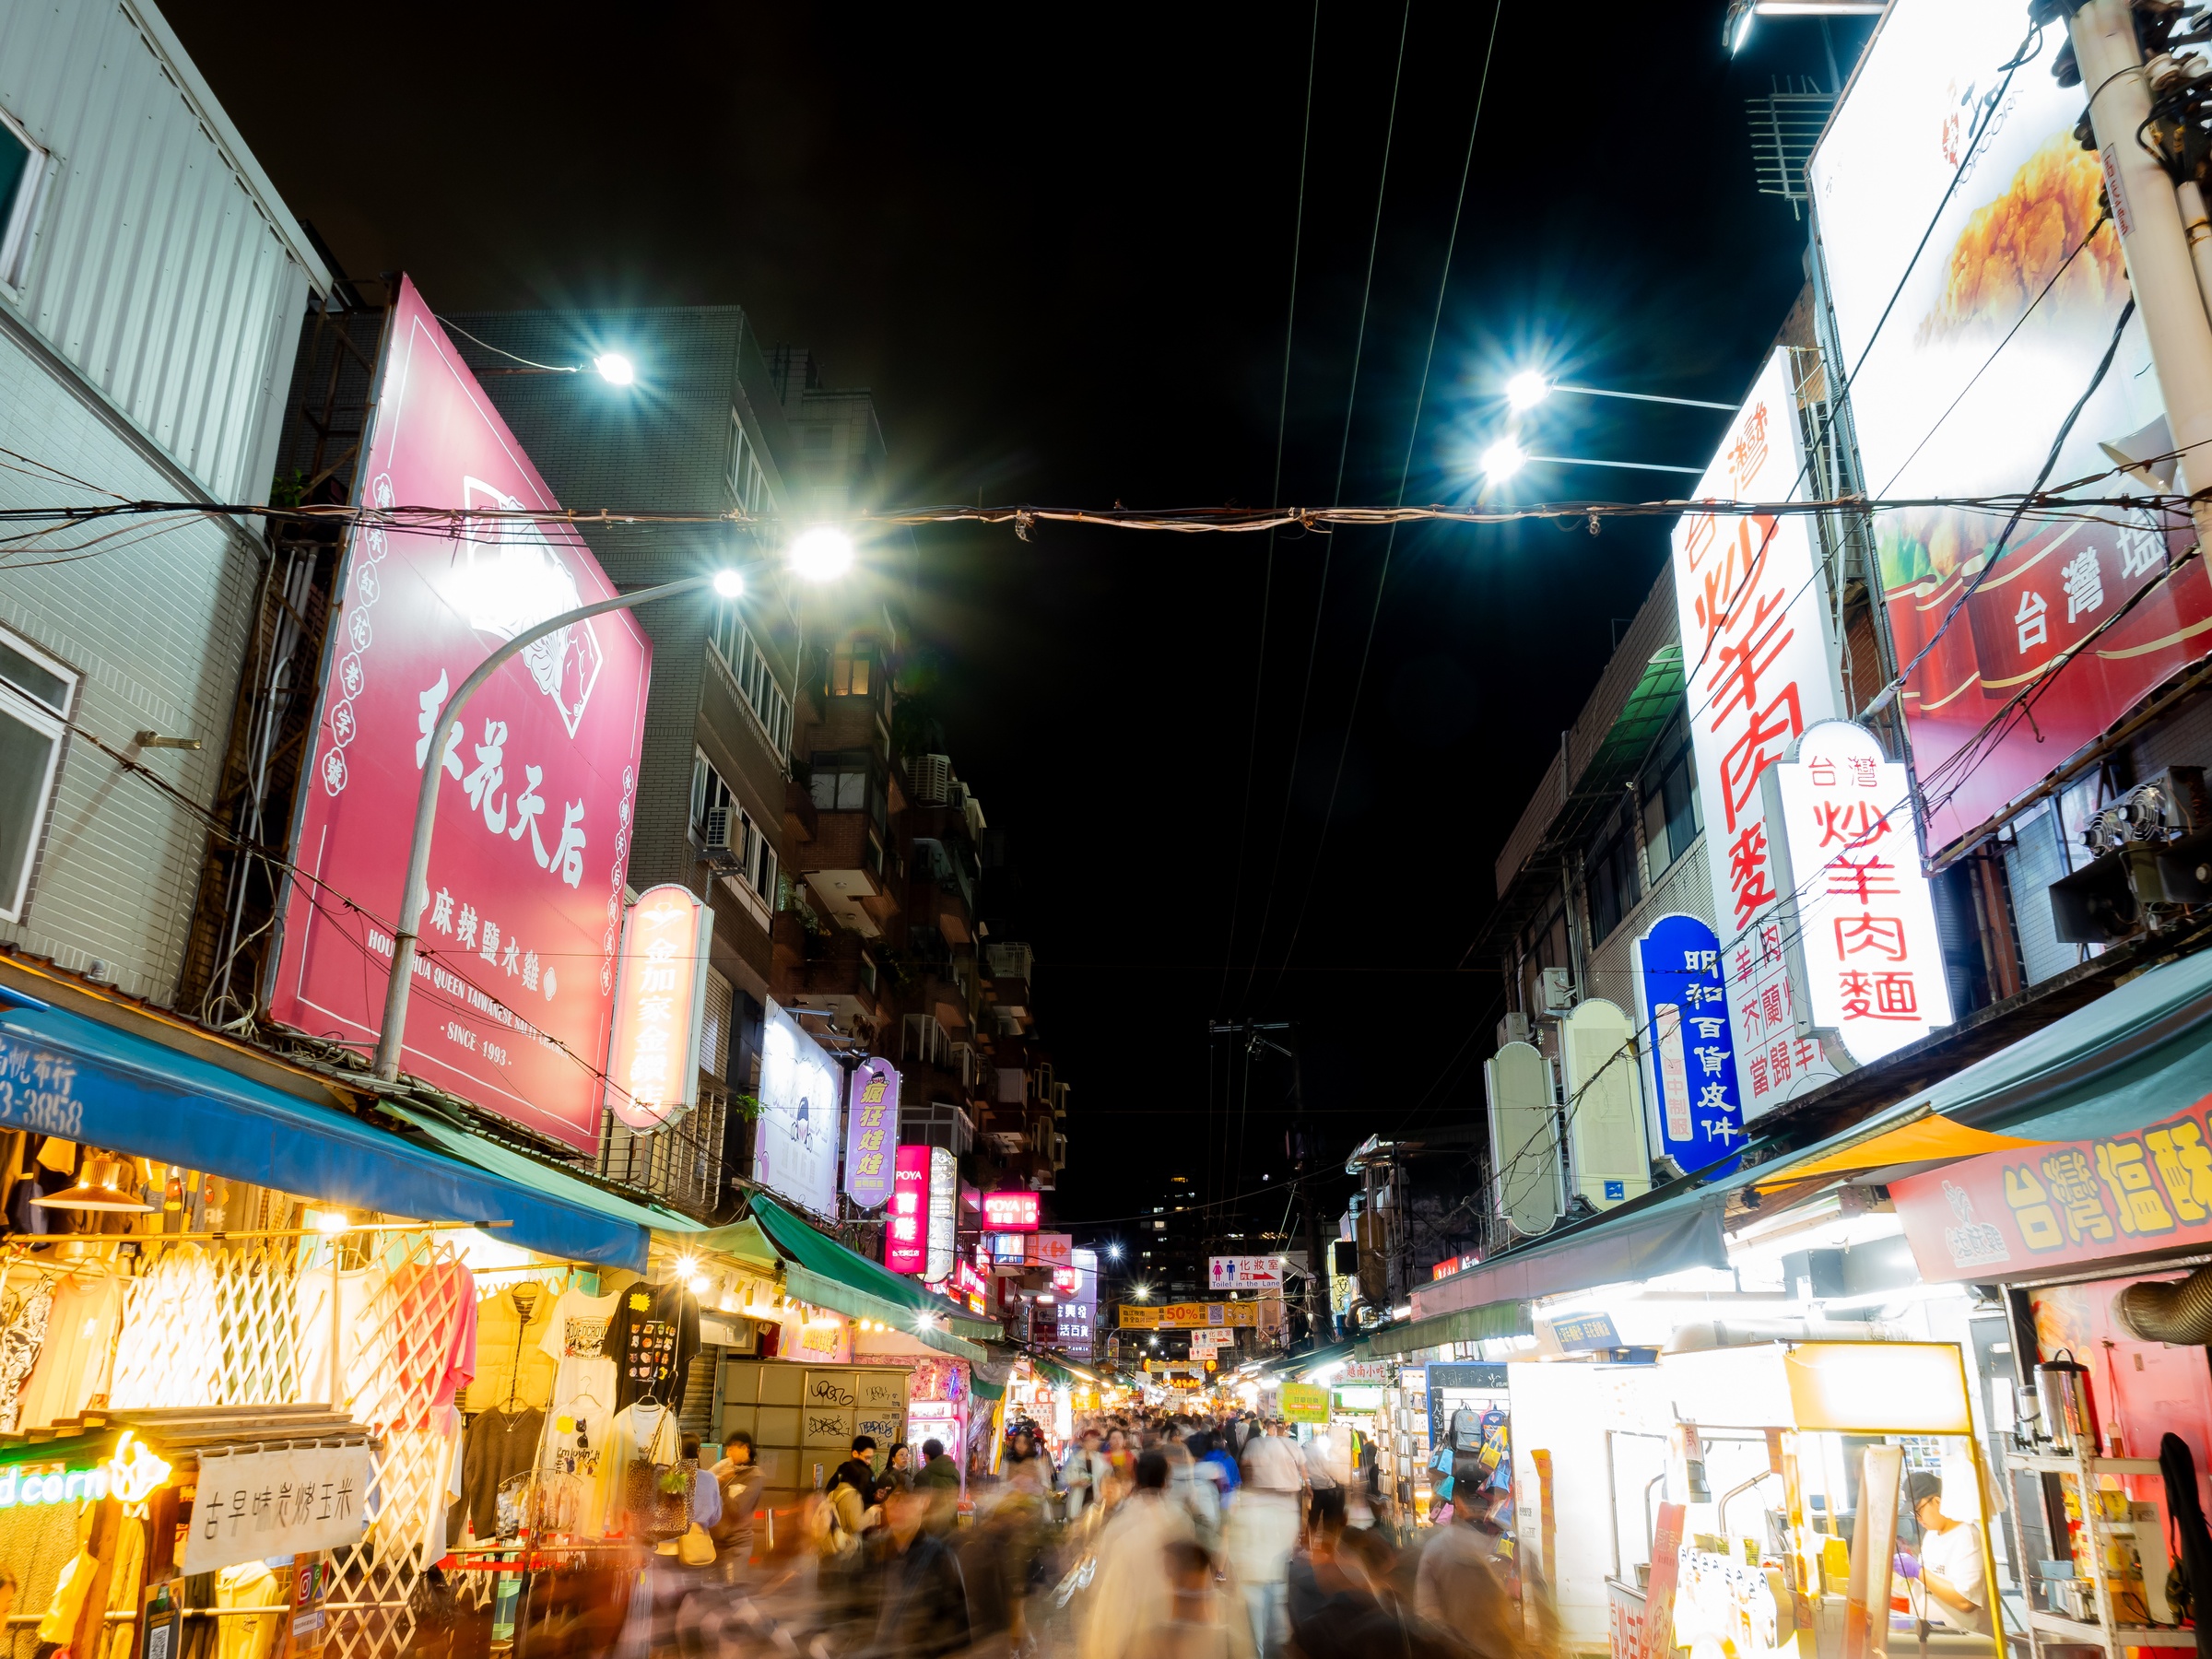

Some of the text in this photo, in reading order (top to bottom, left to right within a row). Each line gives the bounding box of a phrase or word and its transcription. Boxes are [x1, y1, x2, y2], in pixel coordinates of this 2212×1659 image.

[1808, 756, 1877, 787] 台灣
[434, 967, 465, 1002] QUEEN
[447, 1021, 506, 1066] SINCE 1993
[1684, 950, 1739, 1147] 明和百貨皮件
[856, 1083, 888, 1176] 瘋狂娃娃
[896, 1171, 922, 1180] POYA
[985, 1199, 1037, 1212] POYA B1
[1240, 1259, 1278, 1271] 化妝室
[1166, 1306, 1199, 1320] 50%
[1347, 1364, 1385, 1378] 越南小吃
[557, 1447, 570, 1458] I'm
[21, 1470, 105, 1503] corn
